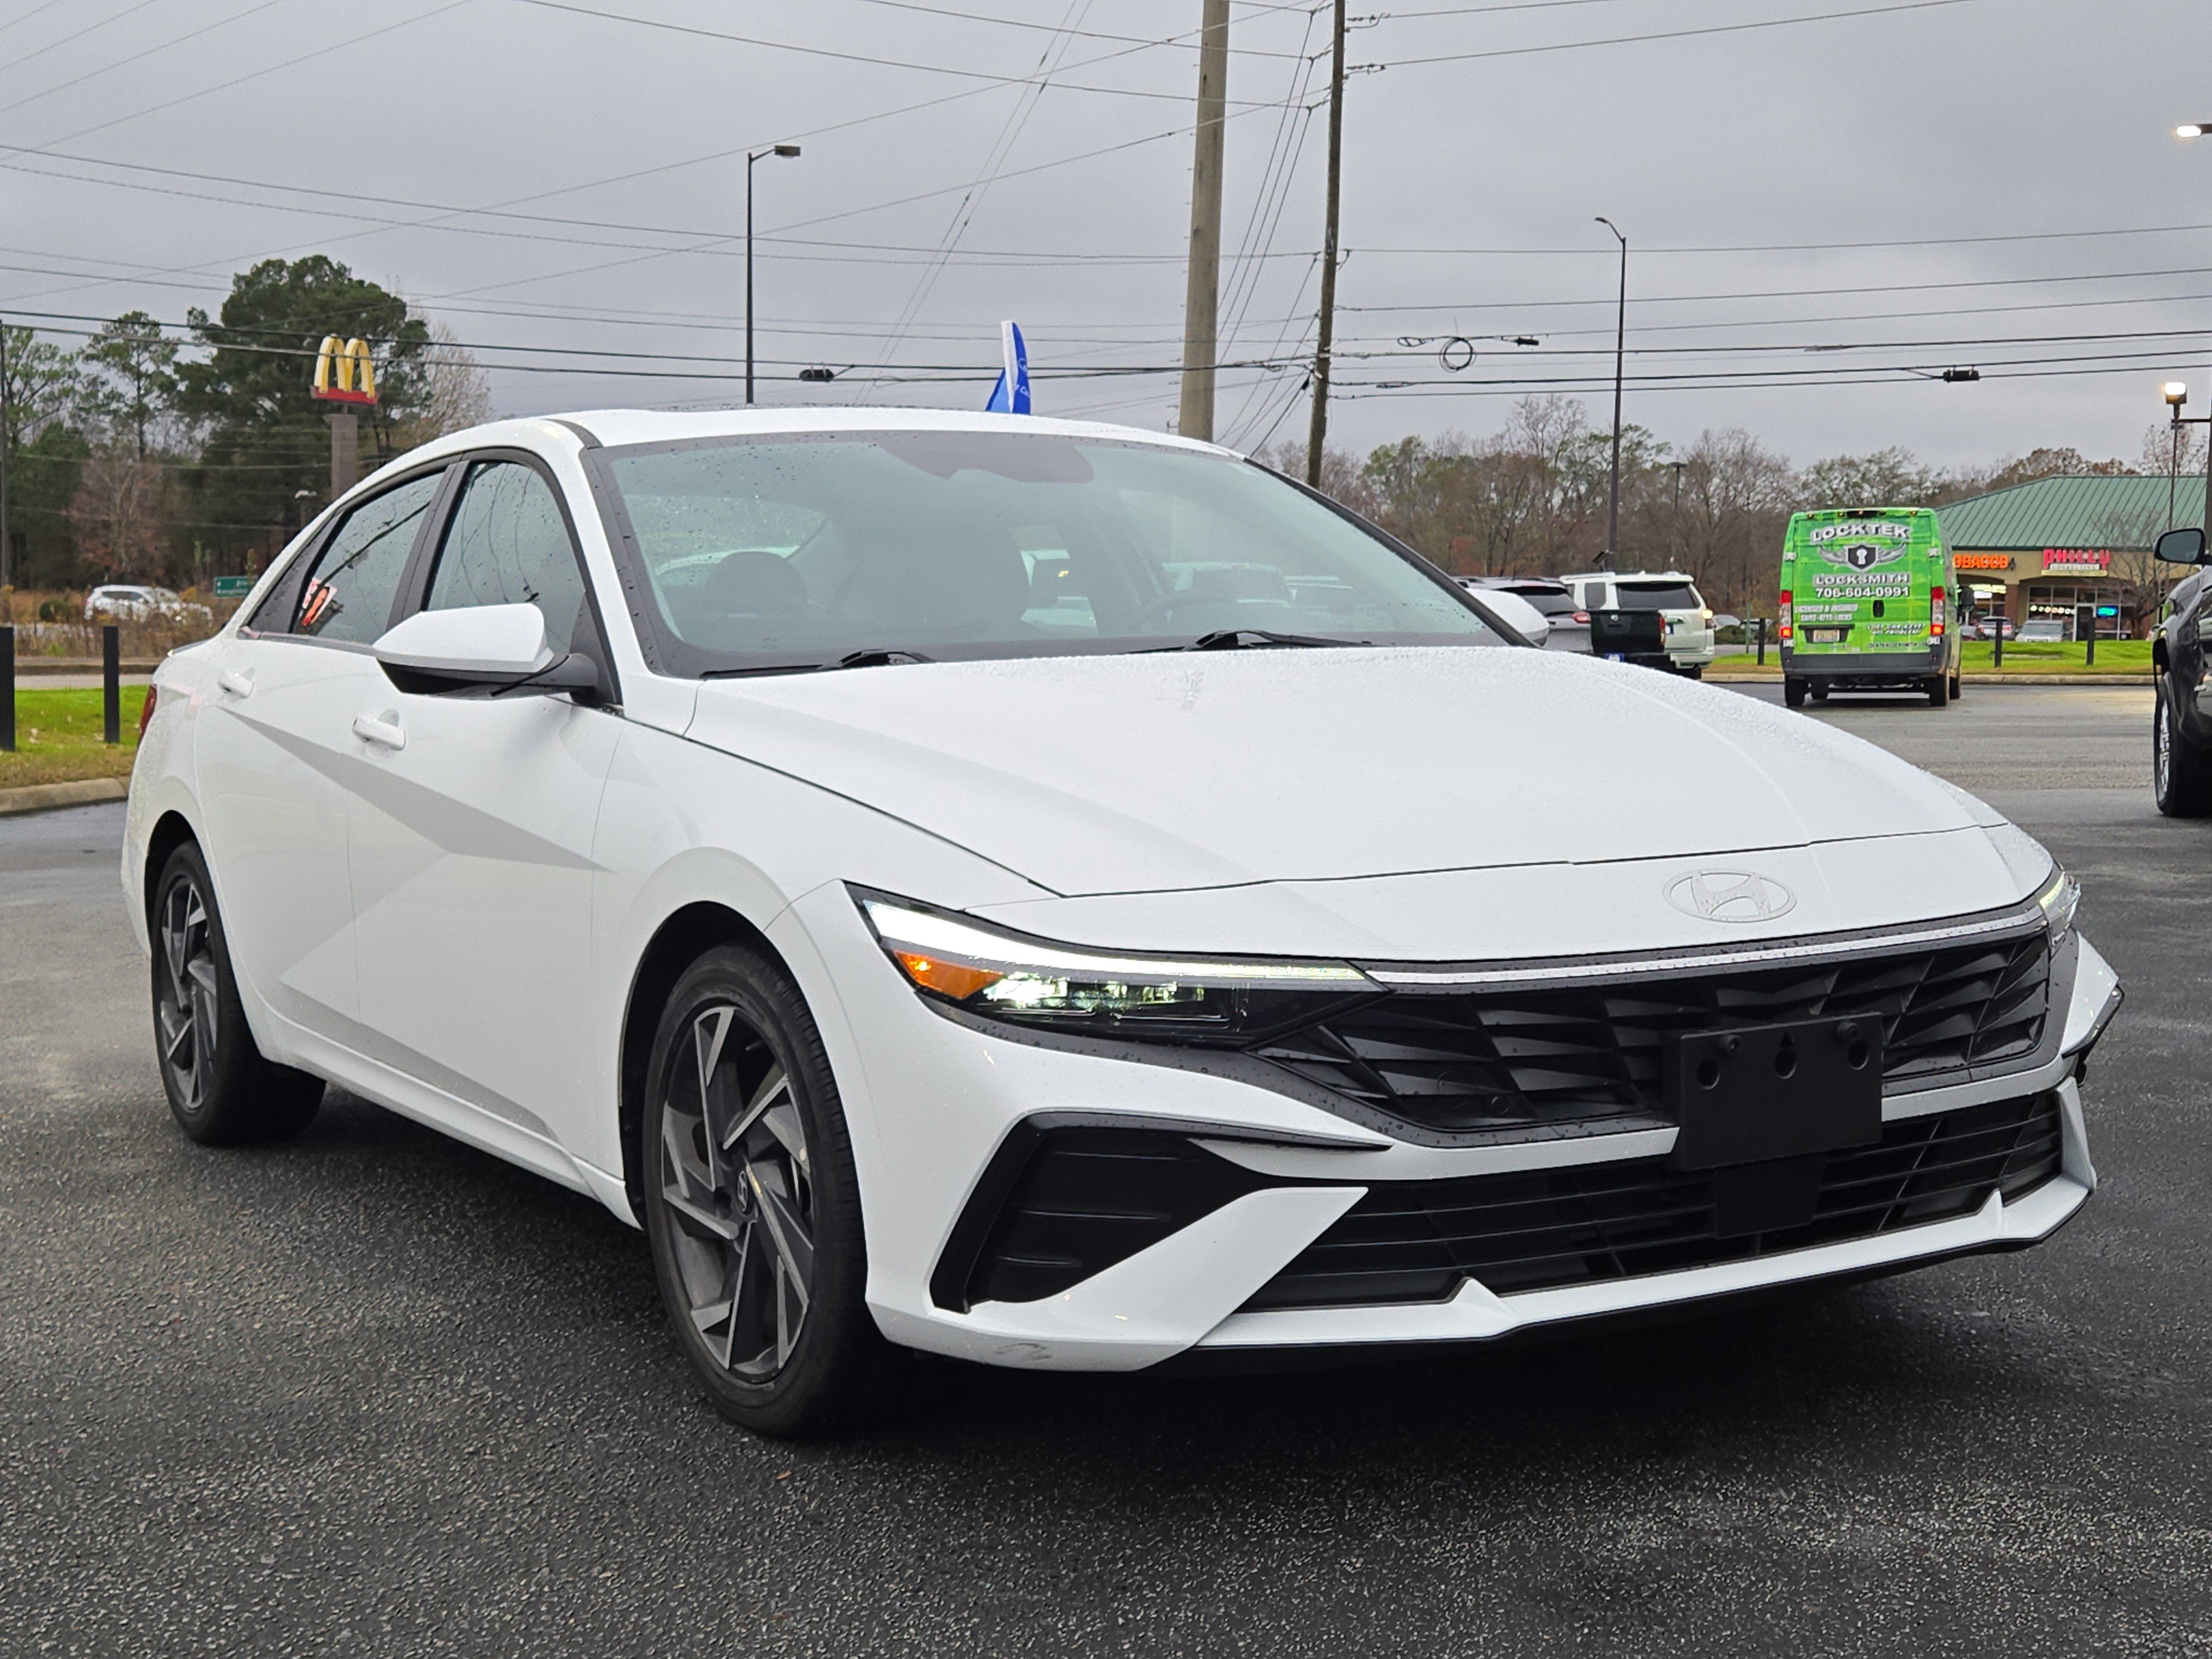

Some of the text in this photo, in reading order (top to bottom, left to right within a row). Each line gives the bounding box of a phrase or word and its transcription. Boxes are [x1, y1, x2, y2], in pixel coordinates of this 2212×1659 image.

[1812, 523, 1911, 543] LOCKTEK
[1953, 554, 2008, 569] OBACCO
[2043, 549, 2111, 569] PHILLY
[1815, 574, 1910, 585] LOCKSMITH
[1815, 586, 1909, 599] 706-604-0991
